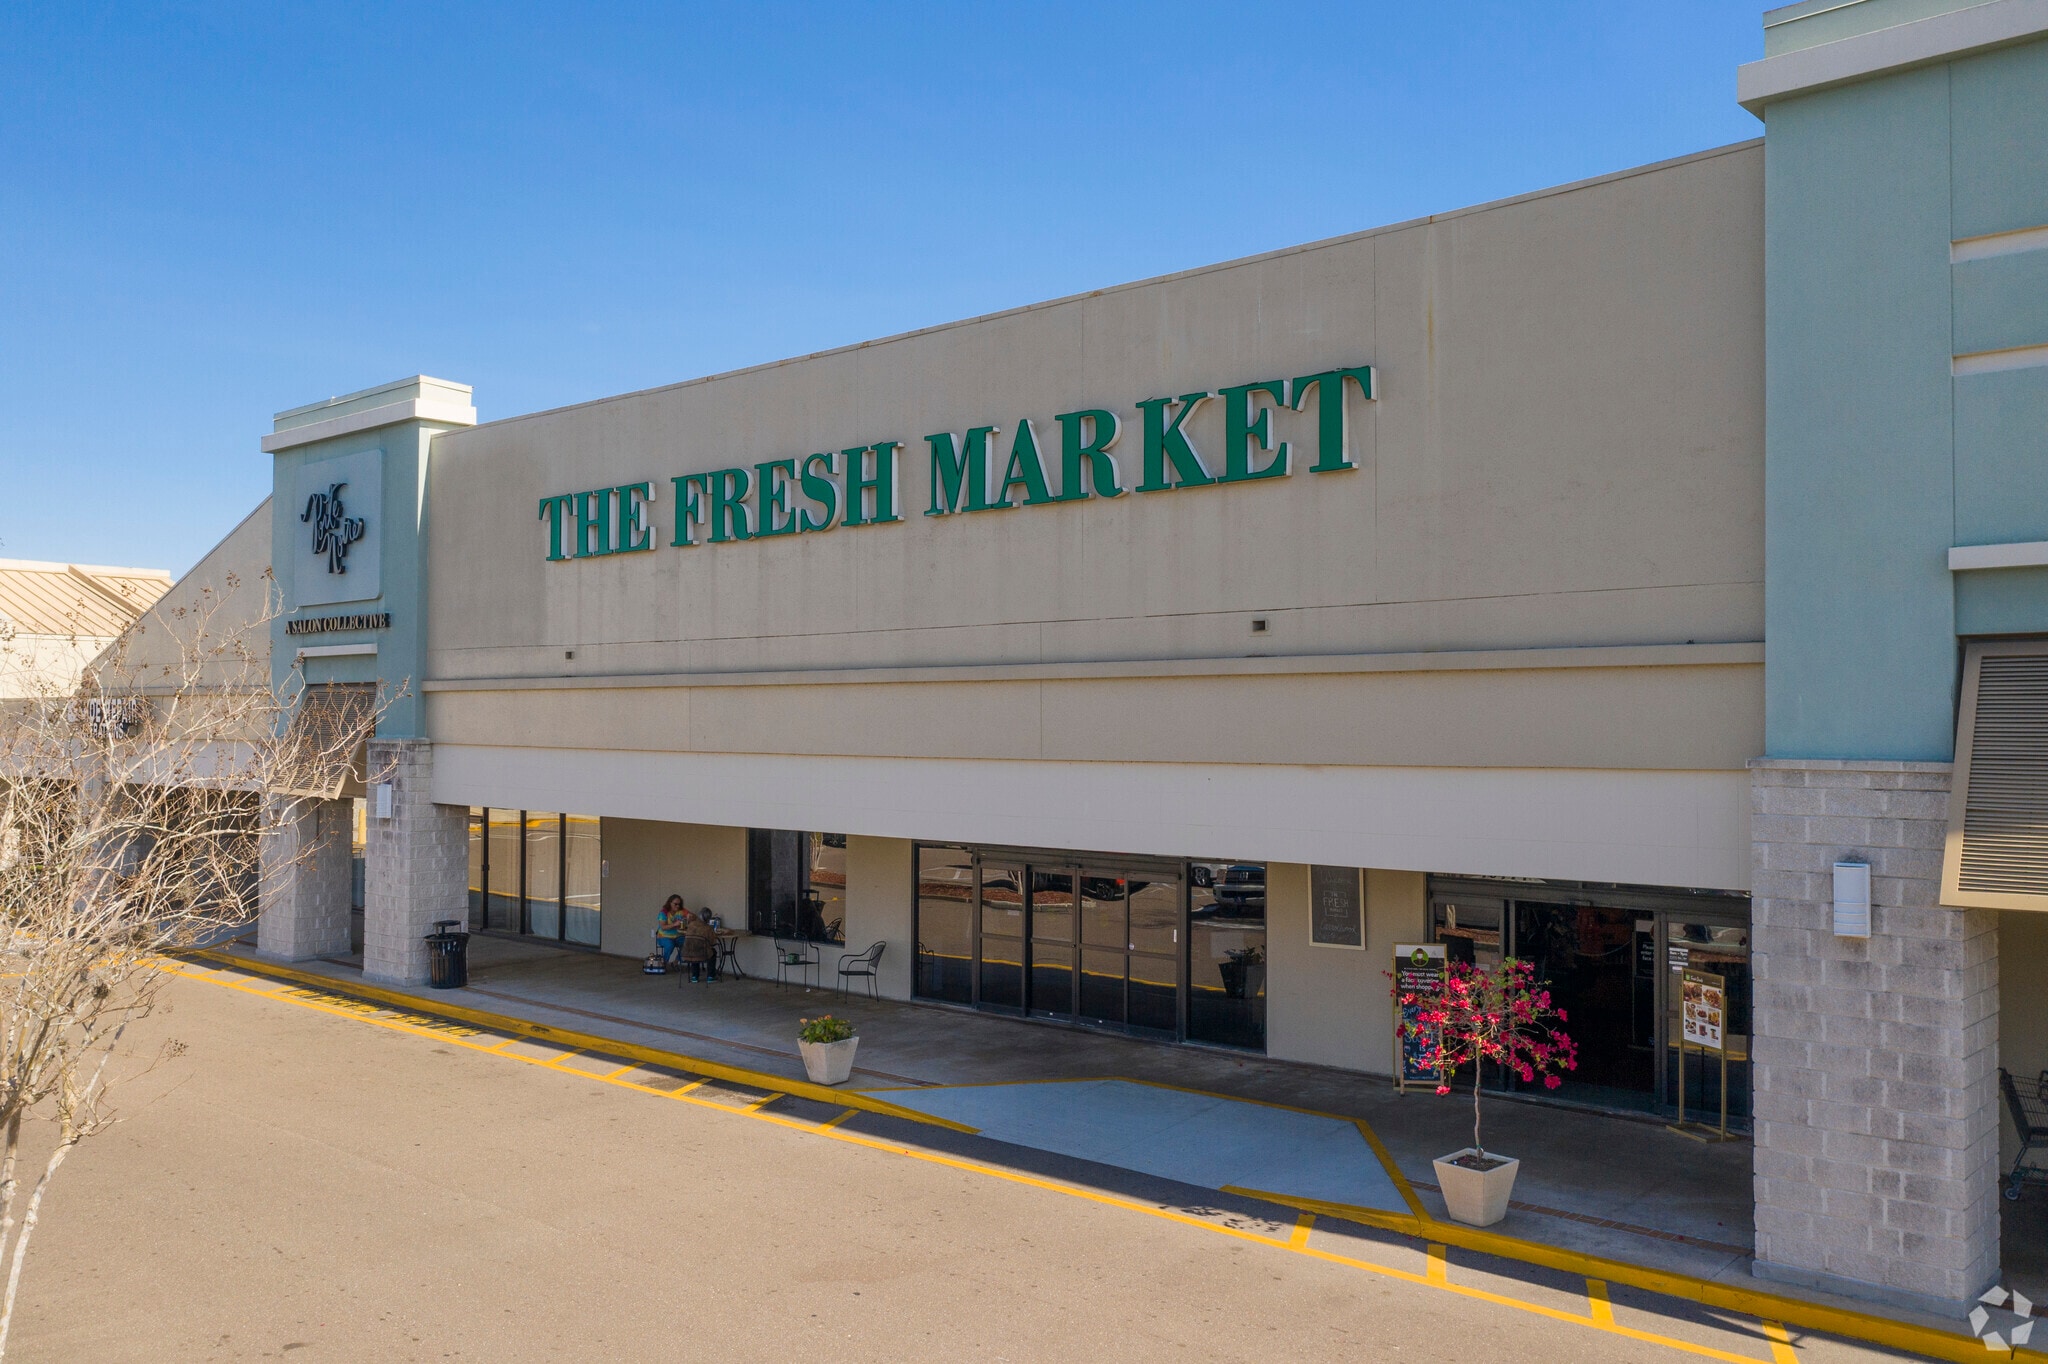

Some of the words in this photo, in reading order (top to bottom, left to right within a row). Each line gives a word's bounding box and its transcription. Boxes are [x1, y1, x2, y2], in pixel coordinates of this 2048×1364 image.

[539, 481, 655, 561] THE
[671, 440, 904, 548] FRESH
[924, 366, 1378, 517] MARKET
[285, 620, 292, 635] A
[292, 618, 322, 635] SALON
[323, 612, 387, 632] COLLECTIVE
